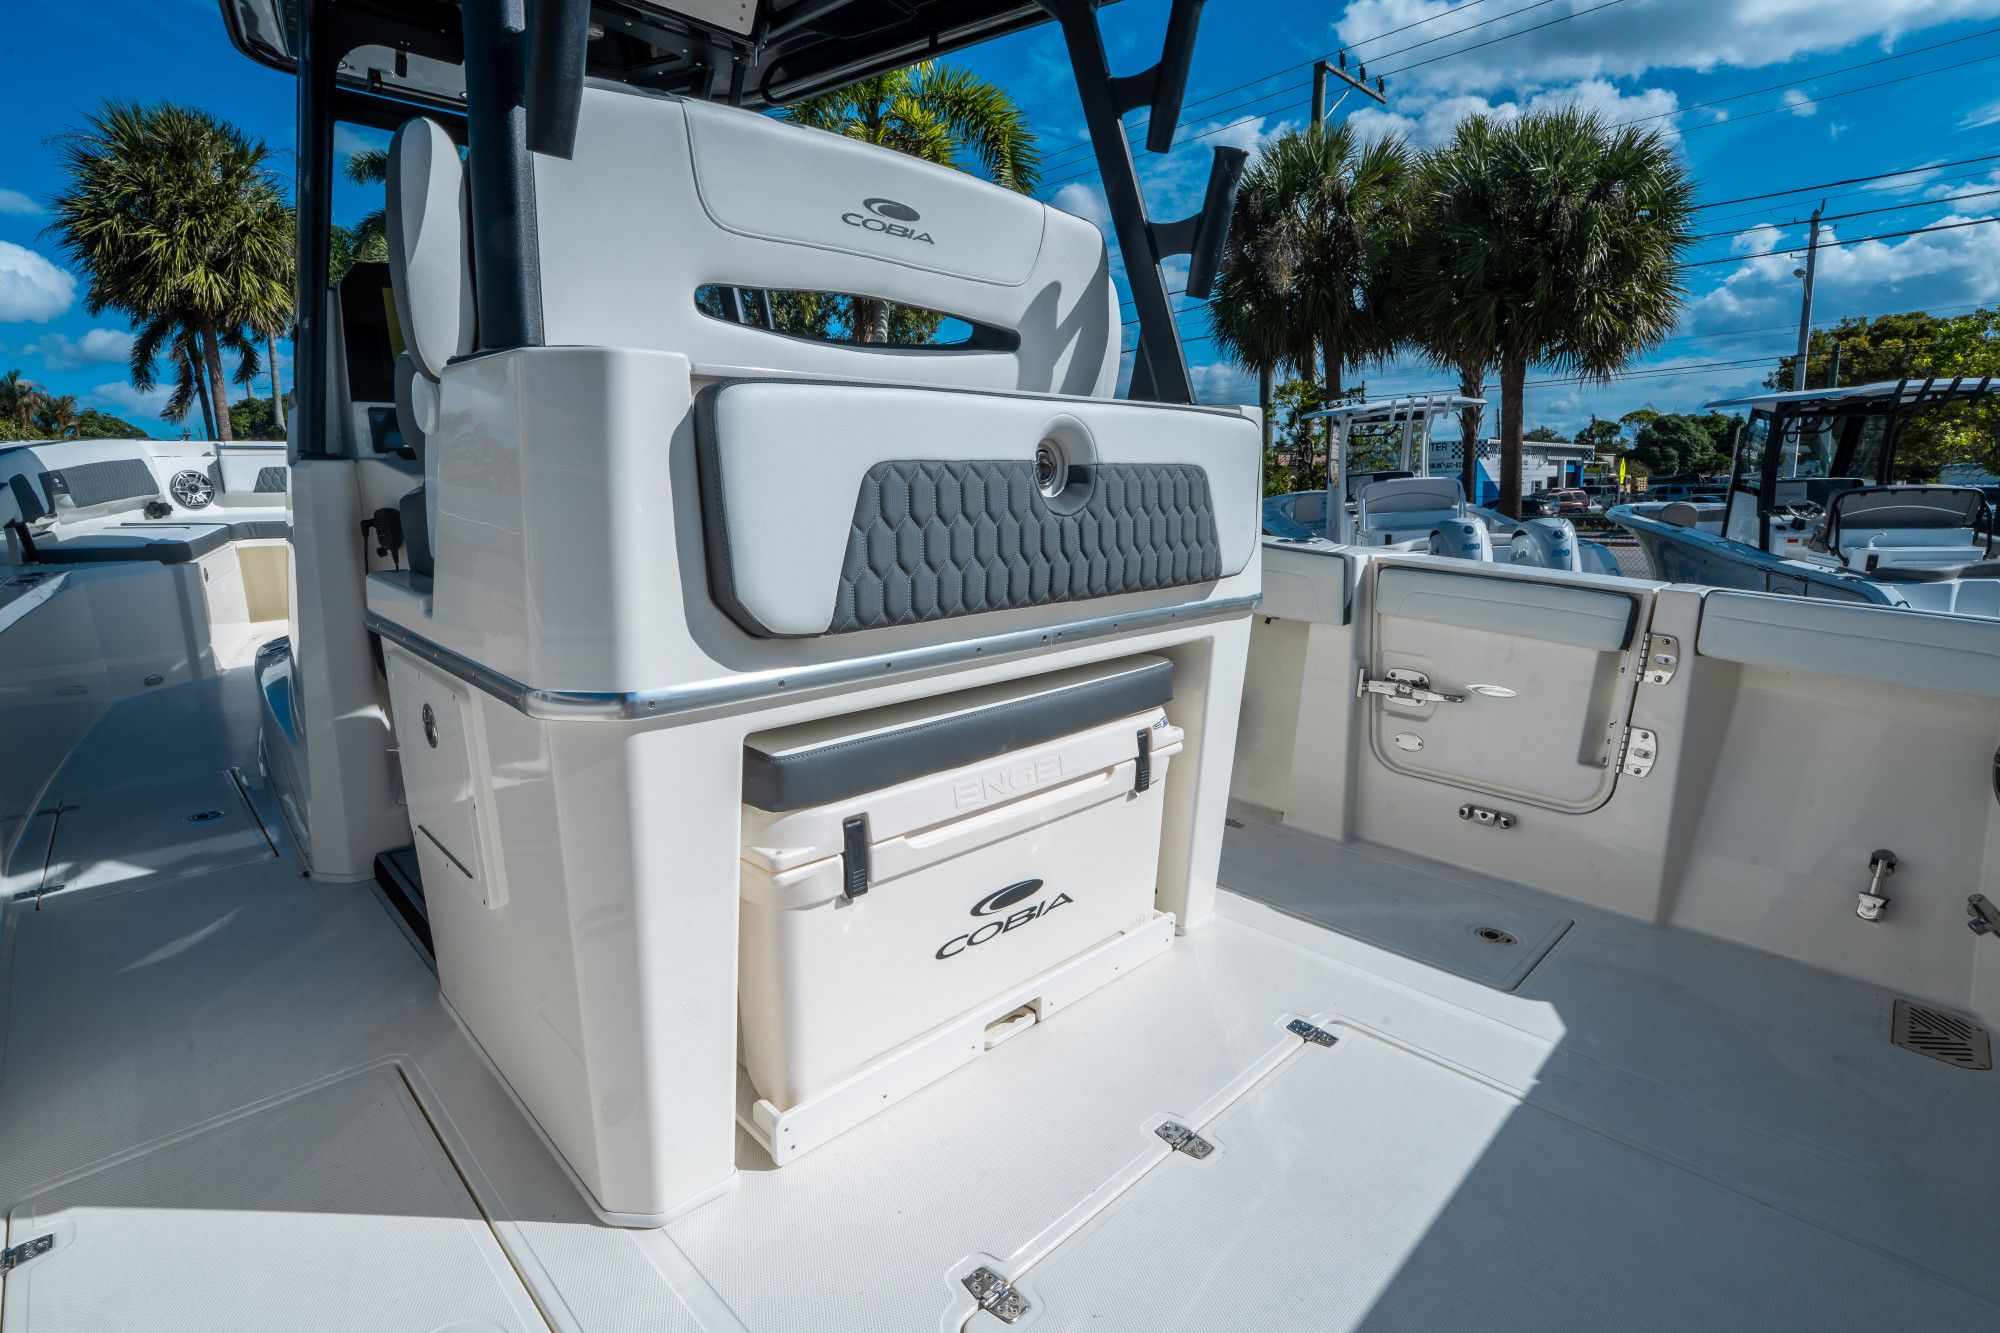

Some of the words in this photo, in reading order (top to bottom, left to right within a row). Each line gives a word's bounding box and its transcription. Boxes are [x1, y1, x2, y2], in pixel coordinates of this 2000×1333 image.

[841, 212, 935, 245] COBIA
[953, 754, 1076, 809] ENGEL
[936, 892, 1073, 960] COBIA
